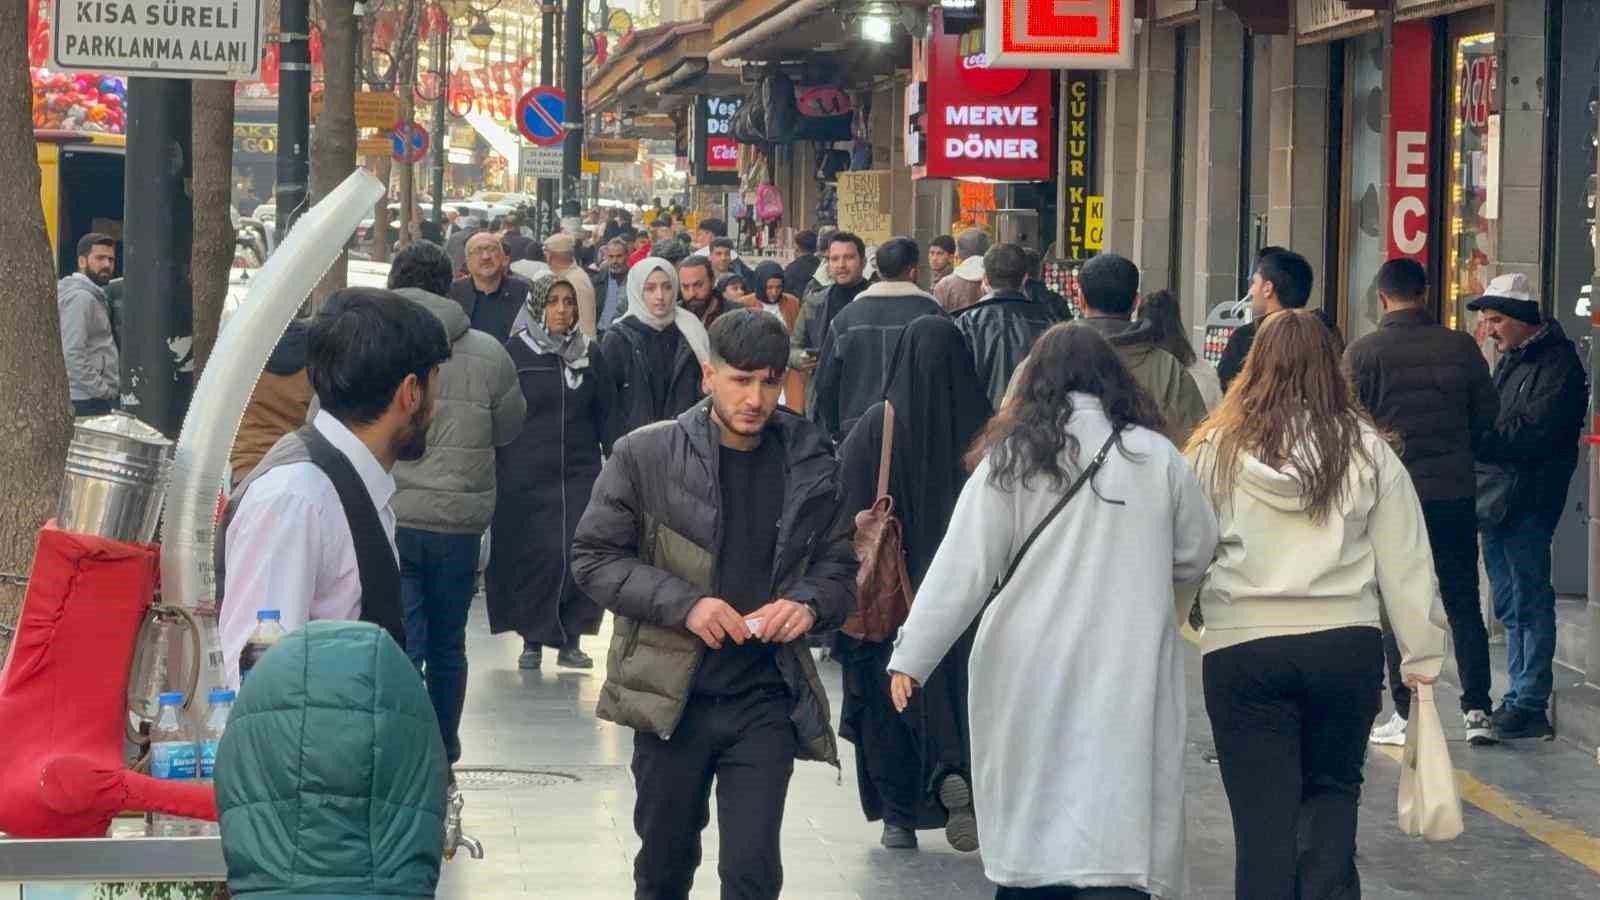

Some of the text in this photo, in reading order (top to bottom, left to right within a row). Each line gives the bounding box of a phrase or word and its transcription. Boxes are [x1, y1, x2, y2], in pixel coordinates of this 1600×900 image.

[77, 0, 237, 28] KISA SÜRELİ
[66, 34, 246, 62] PARKLANMA ALANI
[945, 105, 1038, 126] MERVE
[1069, 81, 1086, 177] ÇUKUR
[945, 133, 1038, 159] DÖNER
